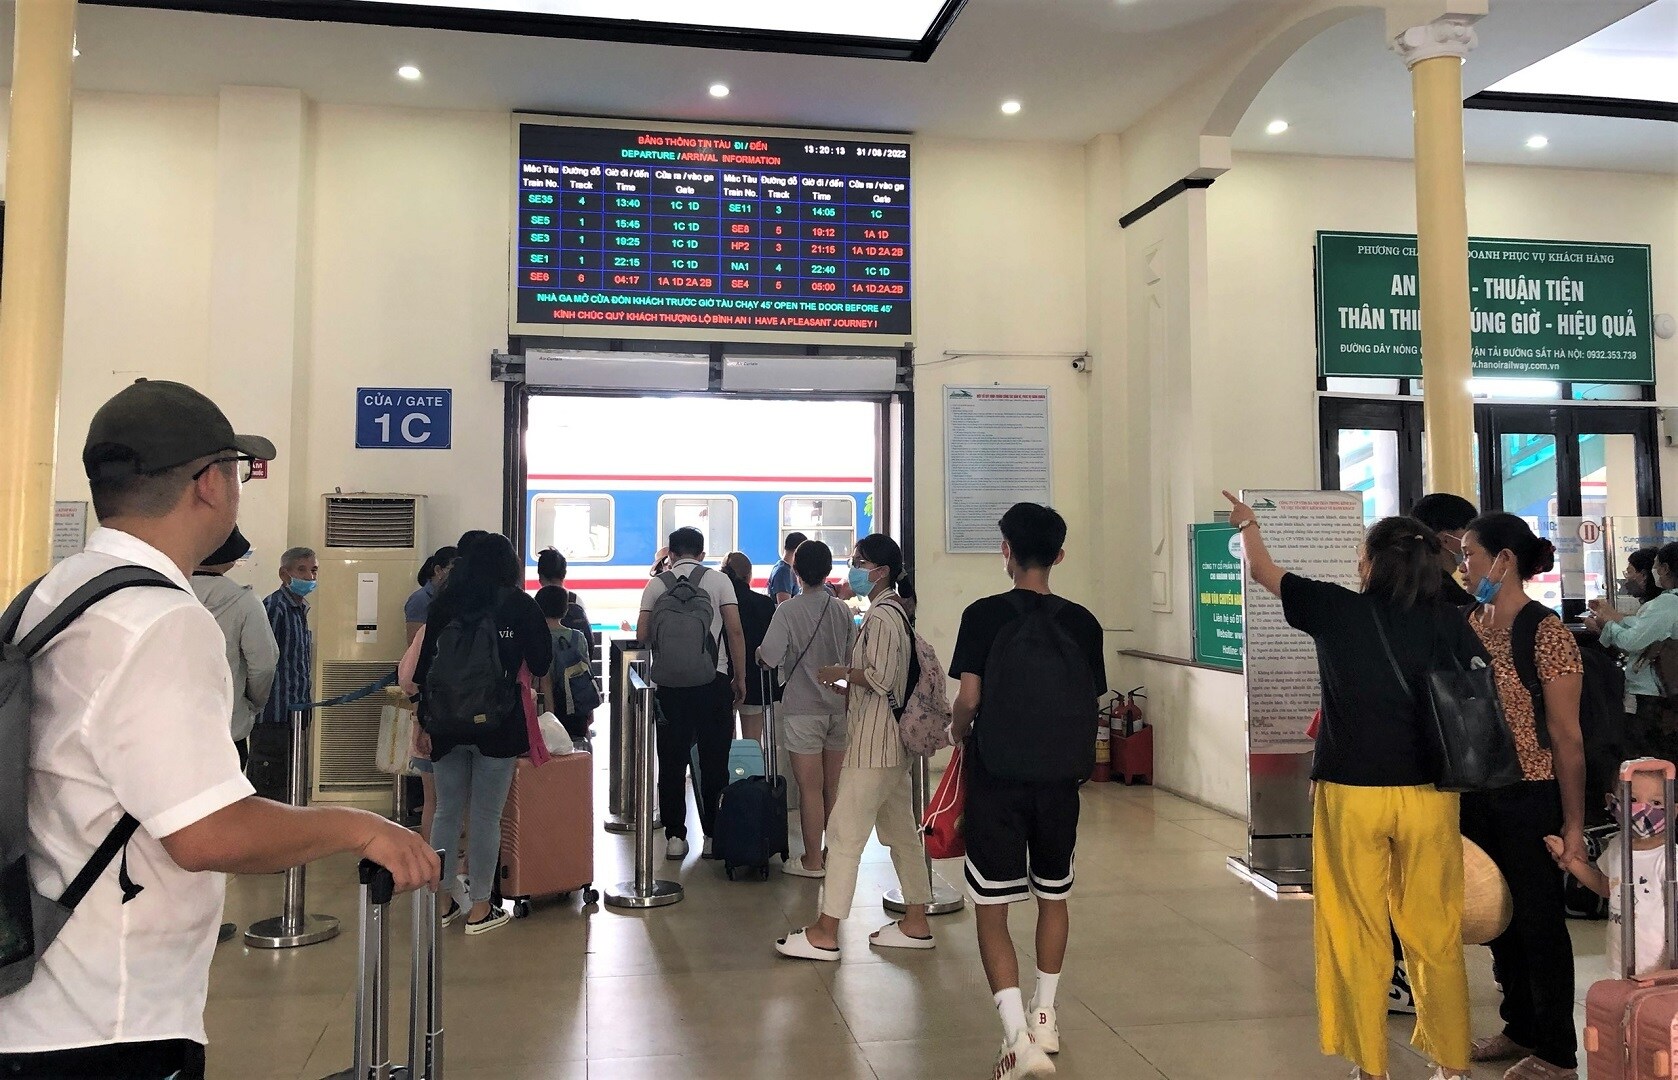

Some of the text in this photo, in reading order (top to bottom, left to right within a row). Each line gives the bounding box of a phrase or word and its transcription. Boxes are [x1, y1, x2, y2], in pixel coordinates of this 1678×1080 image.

[638, 134, 663, 146] BẢNG
[665, 136, 696, 148] THÔNG
[698, 139, 713, 148] TIN
[714, 139, 731, 149] TÀU
[621, 149, 676, 161] DEPARTURE
[722, 154, 781, 166] INFORMATION
[523, 178, 544, 188] Train
[570, 180, 593, 190] Track
[616, 182, 636, 192] Time
[676, 185, 695, 195] Gate
[723, 187, 743, 197] Train
[768, 190, 790, 200] Track
[812, 192, 832, 201] Time
[578, 196, 586, 205] 4
[616, 198, 640, 208] 13:40
[670, 201, 682, 210] 1C
[688, 202, 700, 210] 1D
[728, 204, 882, 218] SE11 3 14:05 1C
[530, 215, 550, 225] SE5
[616, 220, 640, 229] 15:45
[673, 222, 686, 230] 1C
[688, 222, 700, 232] 1D
[530, 233, 550, 242] SE3
[615, 237, 640, 246] 19:25
[672, 239, 685, 248] 1C
[686, 240, 698, 249] 1D
[812, 228, 836, 237] 19:12
[864, 230, 876, 238] 1A
[877, 230, 890, 240] 1D
[731, 242, 904, 256] HP2 3 21:15 1A 1D 2A 2B
[1357, 245, 1400, 256] PHƯƠNG
[1502, 251, 1530, 263] PHỤC
[1532, 252, 1547, 264] VỤ
[1548, 251, 1584, 263] KHÁCH
[1586, 252, 1615, 264] HÀNG
[530, 254, 549, 264] SE1
[614, 257, 640, 267] 22:15
[672, 260, 684, 268] 1C
[686, 260, 698, 270] 1D
[730, 262, 890, 276] NA1 4 22:40 1C 1D
[578, 274, 584, 283] 6
[614, 276, 640, 285] 04:17
[658, 277, 670, 286] 1A
[672, 278, 684, 286] 1D
[686, 278, 699, 287] 2A
[700, 278, 712, 288] 2B
[731, 279, 750, 288] SE4
[776, 281, 782, 290] 5
[811, 282, 836, 292] 05:00
[852, 284, 864, 292] 1A
[1391, 274, 1584, 306] AN THUẬN TIỆN
[537, 292, 557, 302] NHÀ
[558, 294, 573, 303] GA
[590, 292, 610, 304] CỬA
[611, 293, 632, 304] ĐÓN
[632, 294, 664, 306] KHÁCH
[666, 294, 697, 306] TRƯỚC
[698, 296, 714, 307] GIỜ
[716, 298, 733, 308] TÀU
[735, 300, 759, 310] CHẠY
[774, 301, 798, 310] OPEN
[800, 302, 816, 311] THE
[818, 302, 844, 312] DOOR
[845, 304, 879, 313] BEFORE
[554, 309, 873, 328] KÍNH CHÚC QUÝ KHÁCH THƯỢNG LỘ BÌNH AN HAVE A PLEASANT JOURNEY
[1338, 303, 1637, 340] THÂN THI ÚNG GIỜ HIỆU QUẢ
[1340, 343, 1371, 354] ĐƯỜNG
[1373, 342, 1391, 354] DÂY
[1393, 343, 1418, 354] NÓNG
[1488, 346, 1502, 358] TẢI
[1503, 347, 1533, 358] ĐƯỜNG
[1535, 346, 1552, 358] SẮT
[1554, 348, 1566, 359] HÀ
[1567, 348, 1585, 360] NỘI:
[1586, 350, 1638, 360] 0932.353.738
[1472, 360, 1560, 371] w.hanoirailway.com.vn
[364, 391, 393, 406] CỬA
[406, 396, 443, 407] GATE
[1039, 1012, 1047, 1024] B
[990, 1051, 1016, 1080] STON
